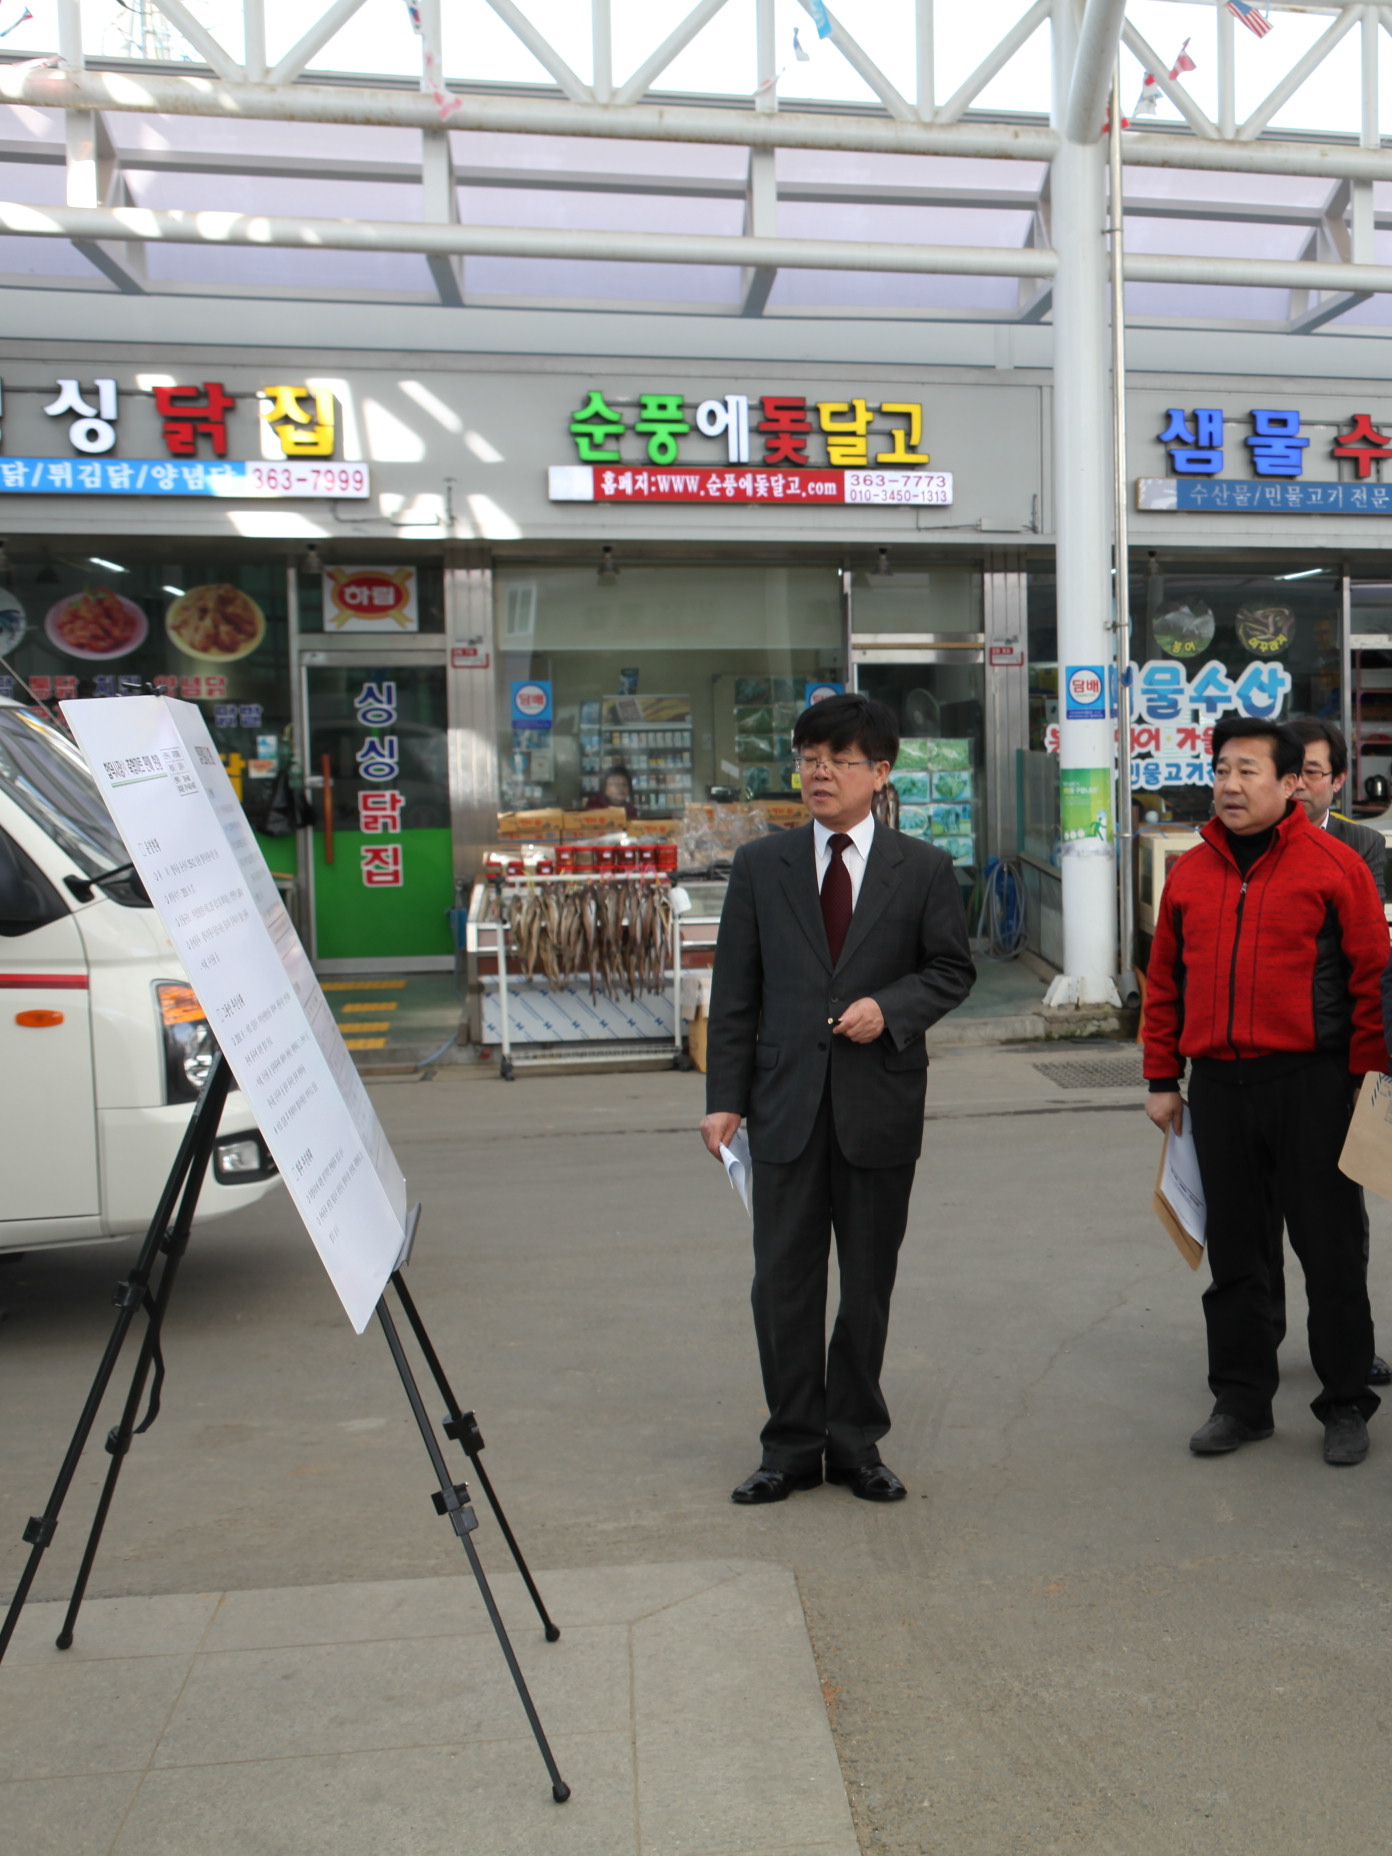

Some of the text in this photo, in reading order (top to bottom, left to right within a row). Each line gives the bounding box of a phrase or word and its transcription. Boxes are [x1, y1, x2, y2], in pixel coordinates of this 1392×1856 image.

[0, 378, 336, 455] 싱닭집
[569, 390, 930, 467] 순풍에돛달고
[252, 468, 365, 492] 363-7999
[850, 474, 946, 488] 363-7773
[850, 489, 947, 502] 010-3450-1313
[1349, 485, 1390, 510] 전문
[343, 585, 396, 607] 하림
[1072, 679, 1099, 693] 담배
[1110, 663, 1287, 719] 물수산
